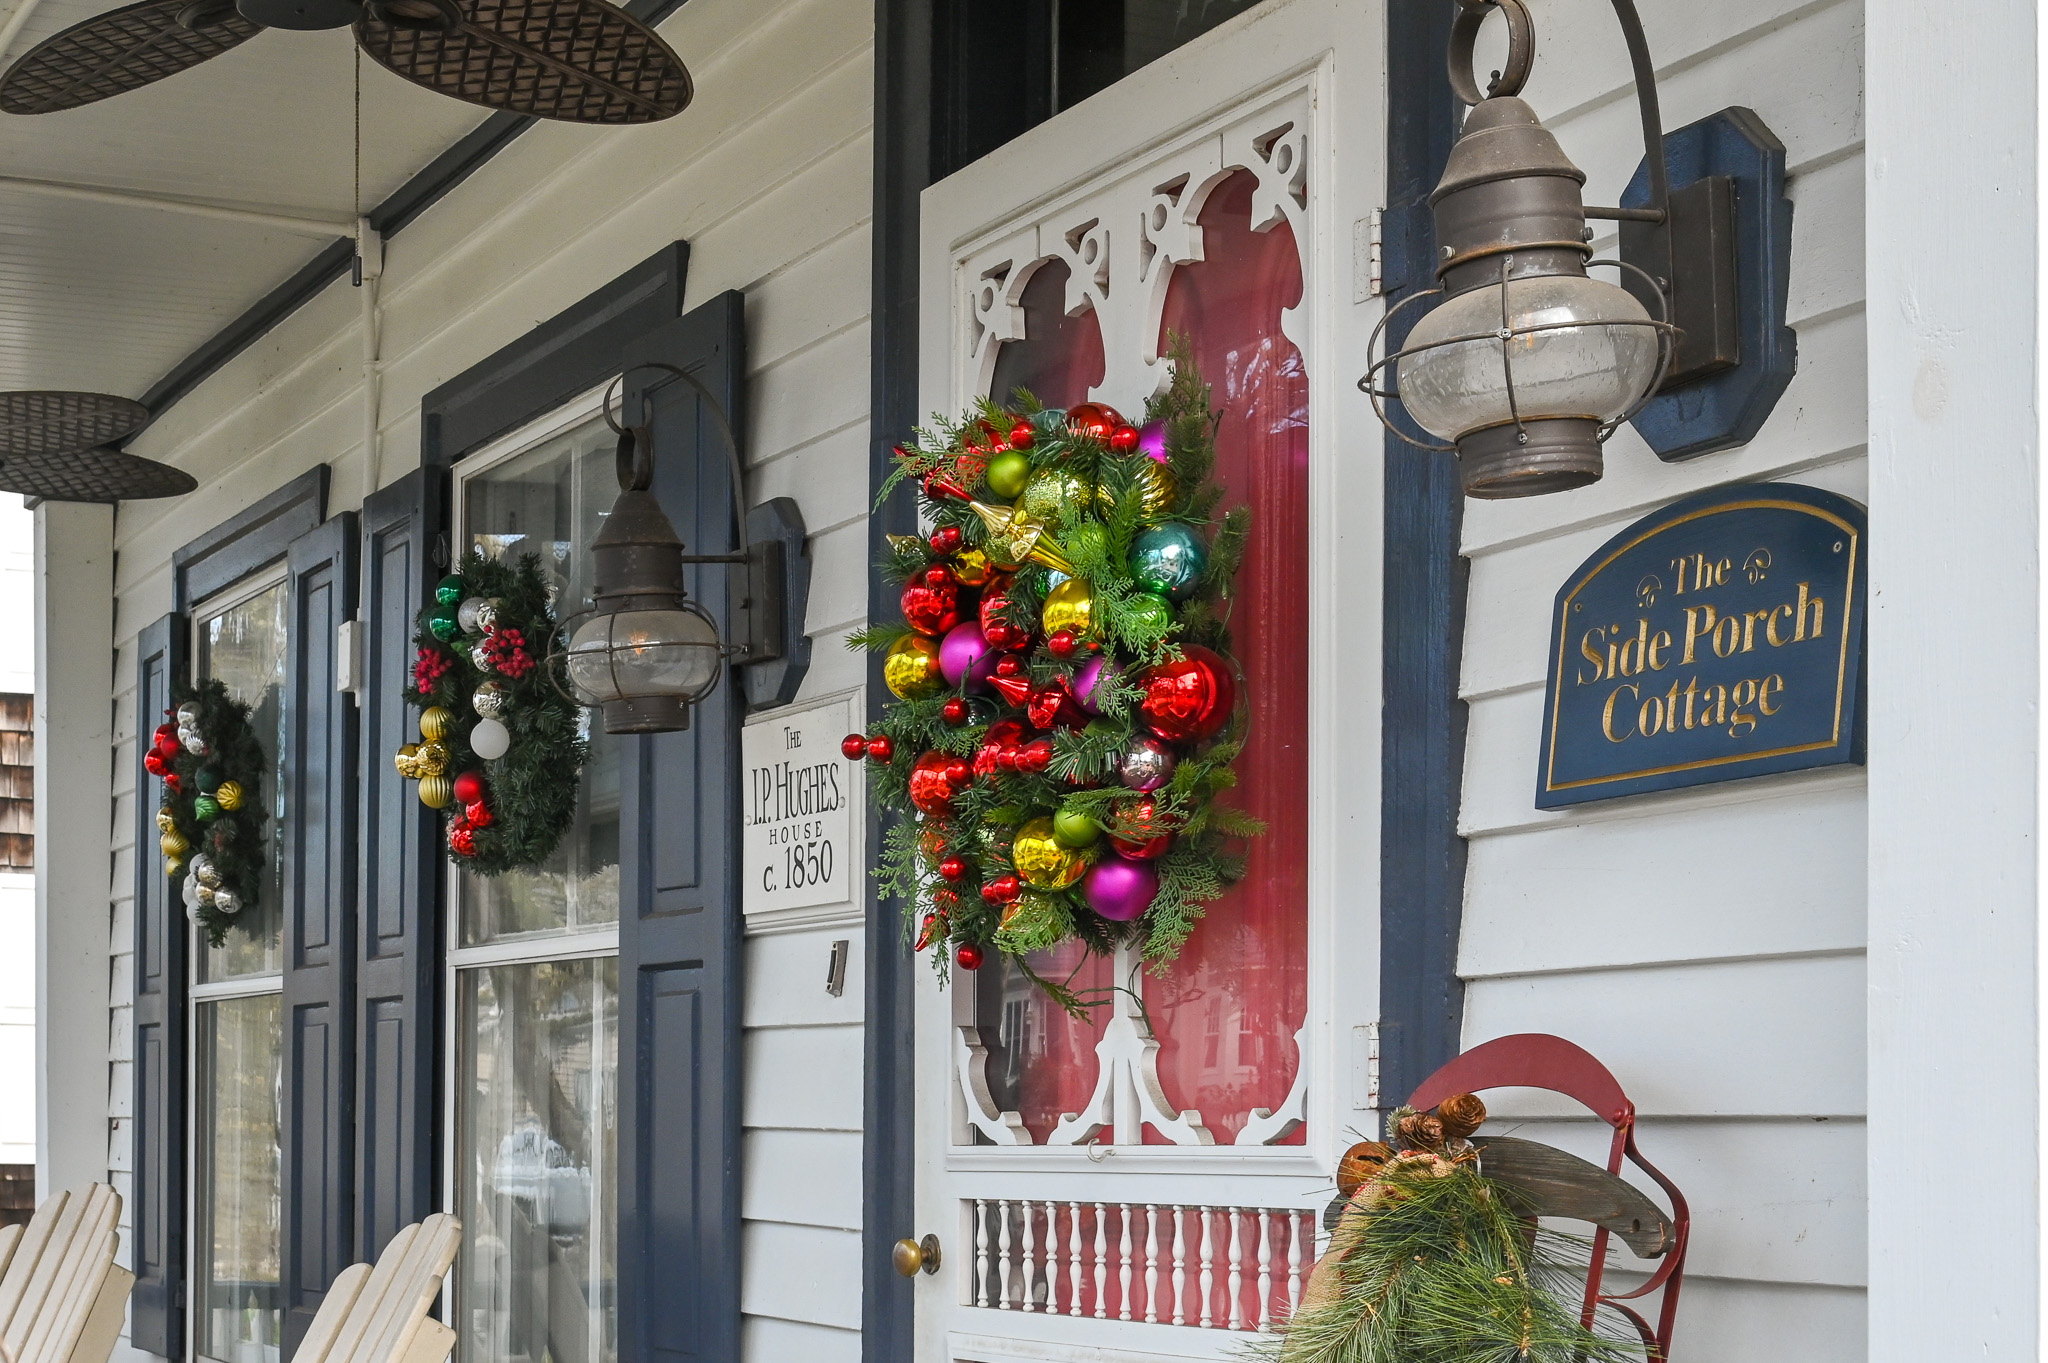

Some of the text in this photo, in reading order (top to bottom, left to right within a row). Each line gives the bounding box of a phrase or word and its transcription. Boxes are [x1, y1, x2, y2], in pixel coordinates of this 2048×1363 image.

[1670, 552, 1731, 595] The
[1577, 581, 1825, 687] Side Porch
[1602, 673, 1784, 743] Cottage
[784, 726, 801, 750] THE
[775, 761, 839, 822] HUGHES
[769, 821, 822, 844] HOUSE
[763, 839, 832, 892] c. 1850
